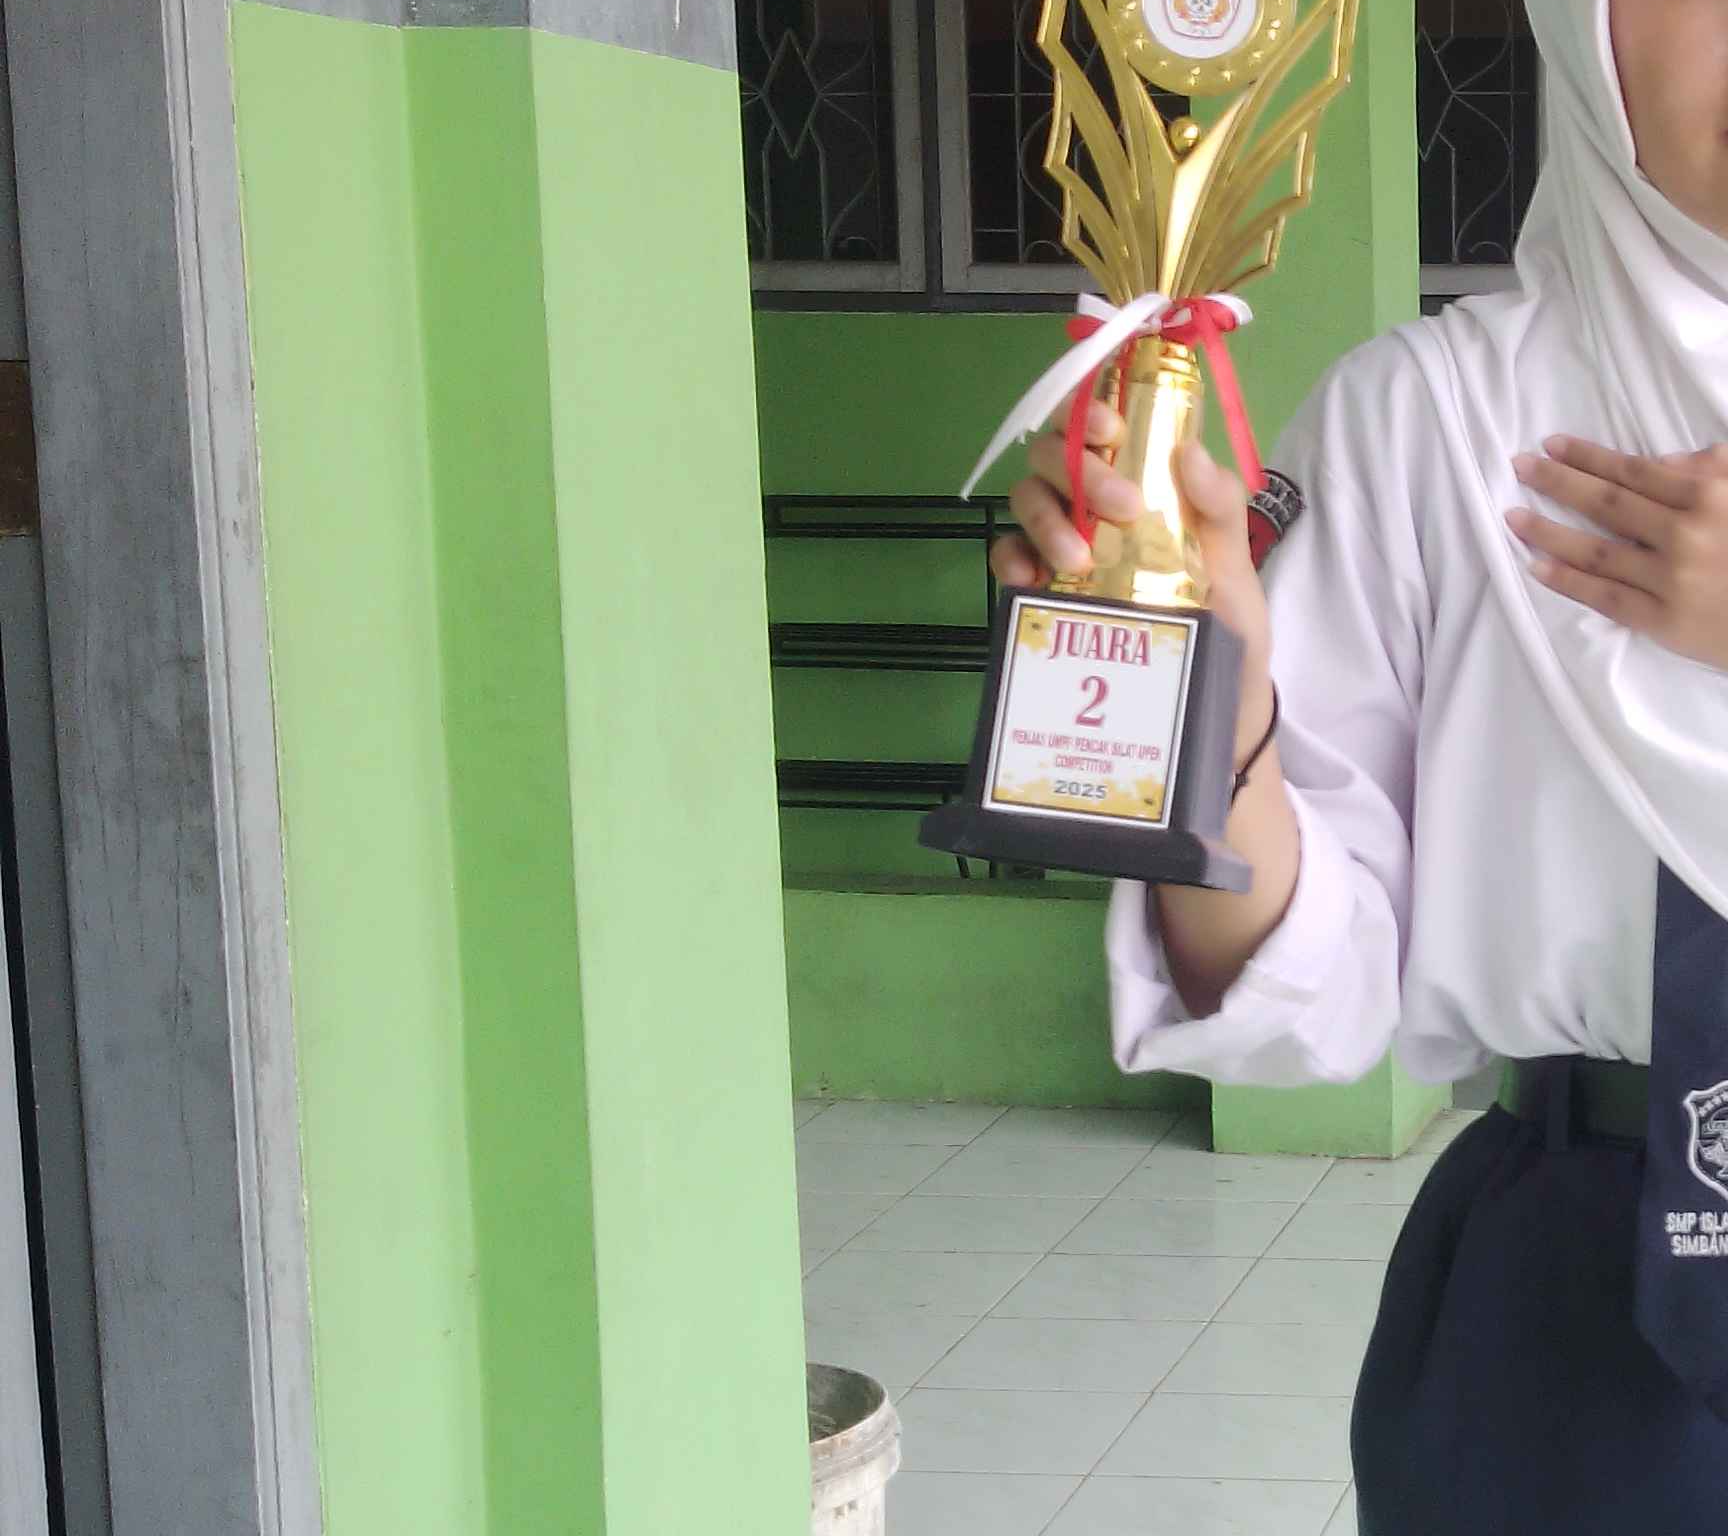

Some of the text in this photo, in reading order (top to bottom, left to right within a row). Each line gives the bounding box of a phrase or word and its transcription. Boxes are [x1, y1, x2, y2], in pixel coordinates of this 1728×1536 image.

[1048, 620, 1150, 666] JUARA
[1075, 675, 1109, 727] 2
[1055, 754, 1115, 773] COMPETITION
[1054, 779, 1108, 800] 2025
[1665, 1211, 1697, 1233] SMP
